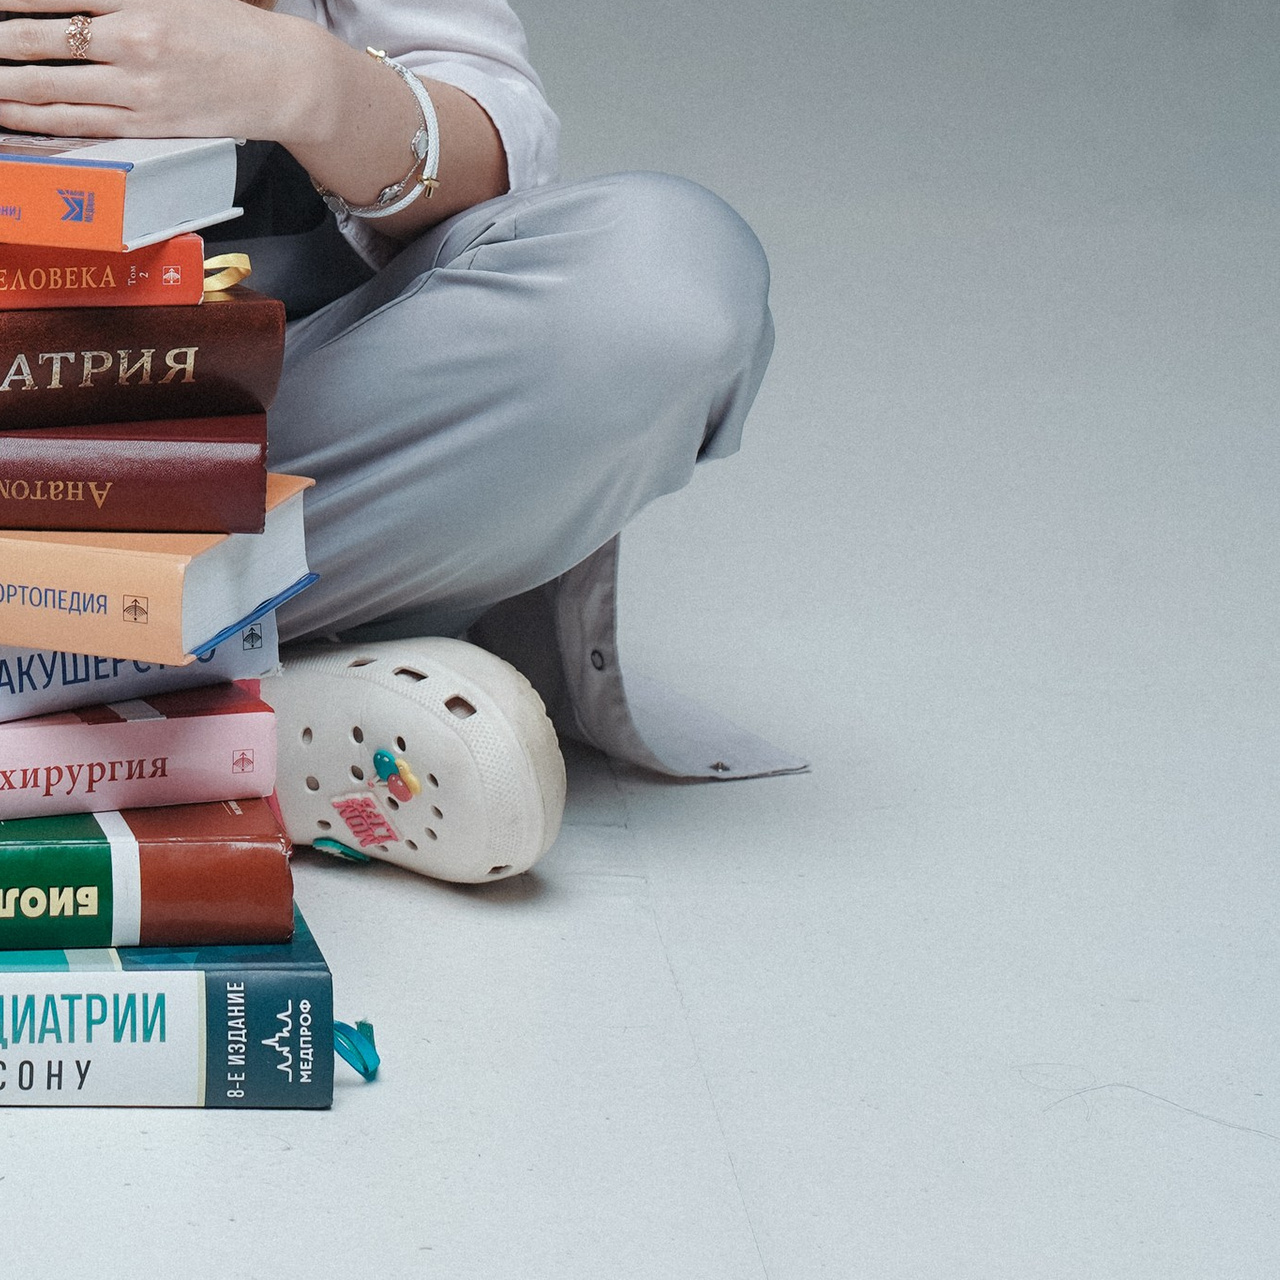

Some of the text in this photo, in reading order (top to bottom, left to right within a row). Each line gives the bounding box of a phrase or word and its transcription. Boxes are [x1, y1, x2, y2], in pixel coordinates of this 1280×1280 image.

[127, 265, 137, 286] Том
[226, 981, 247, 1098] 8-Е ИЗДАНИЕ
[299, 999, 314, 1083] МЕДПРОФ
